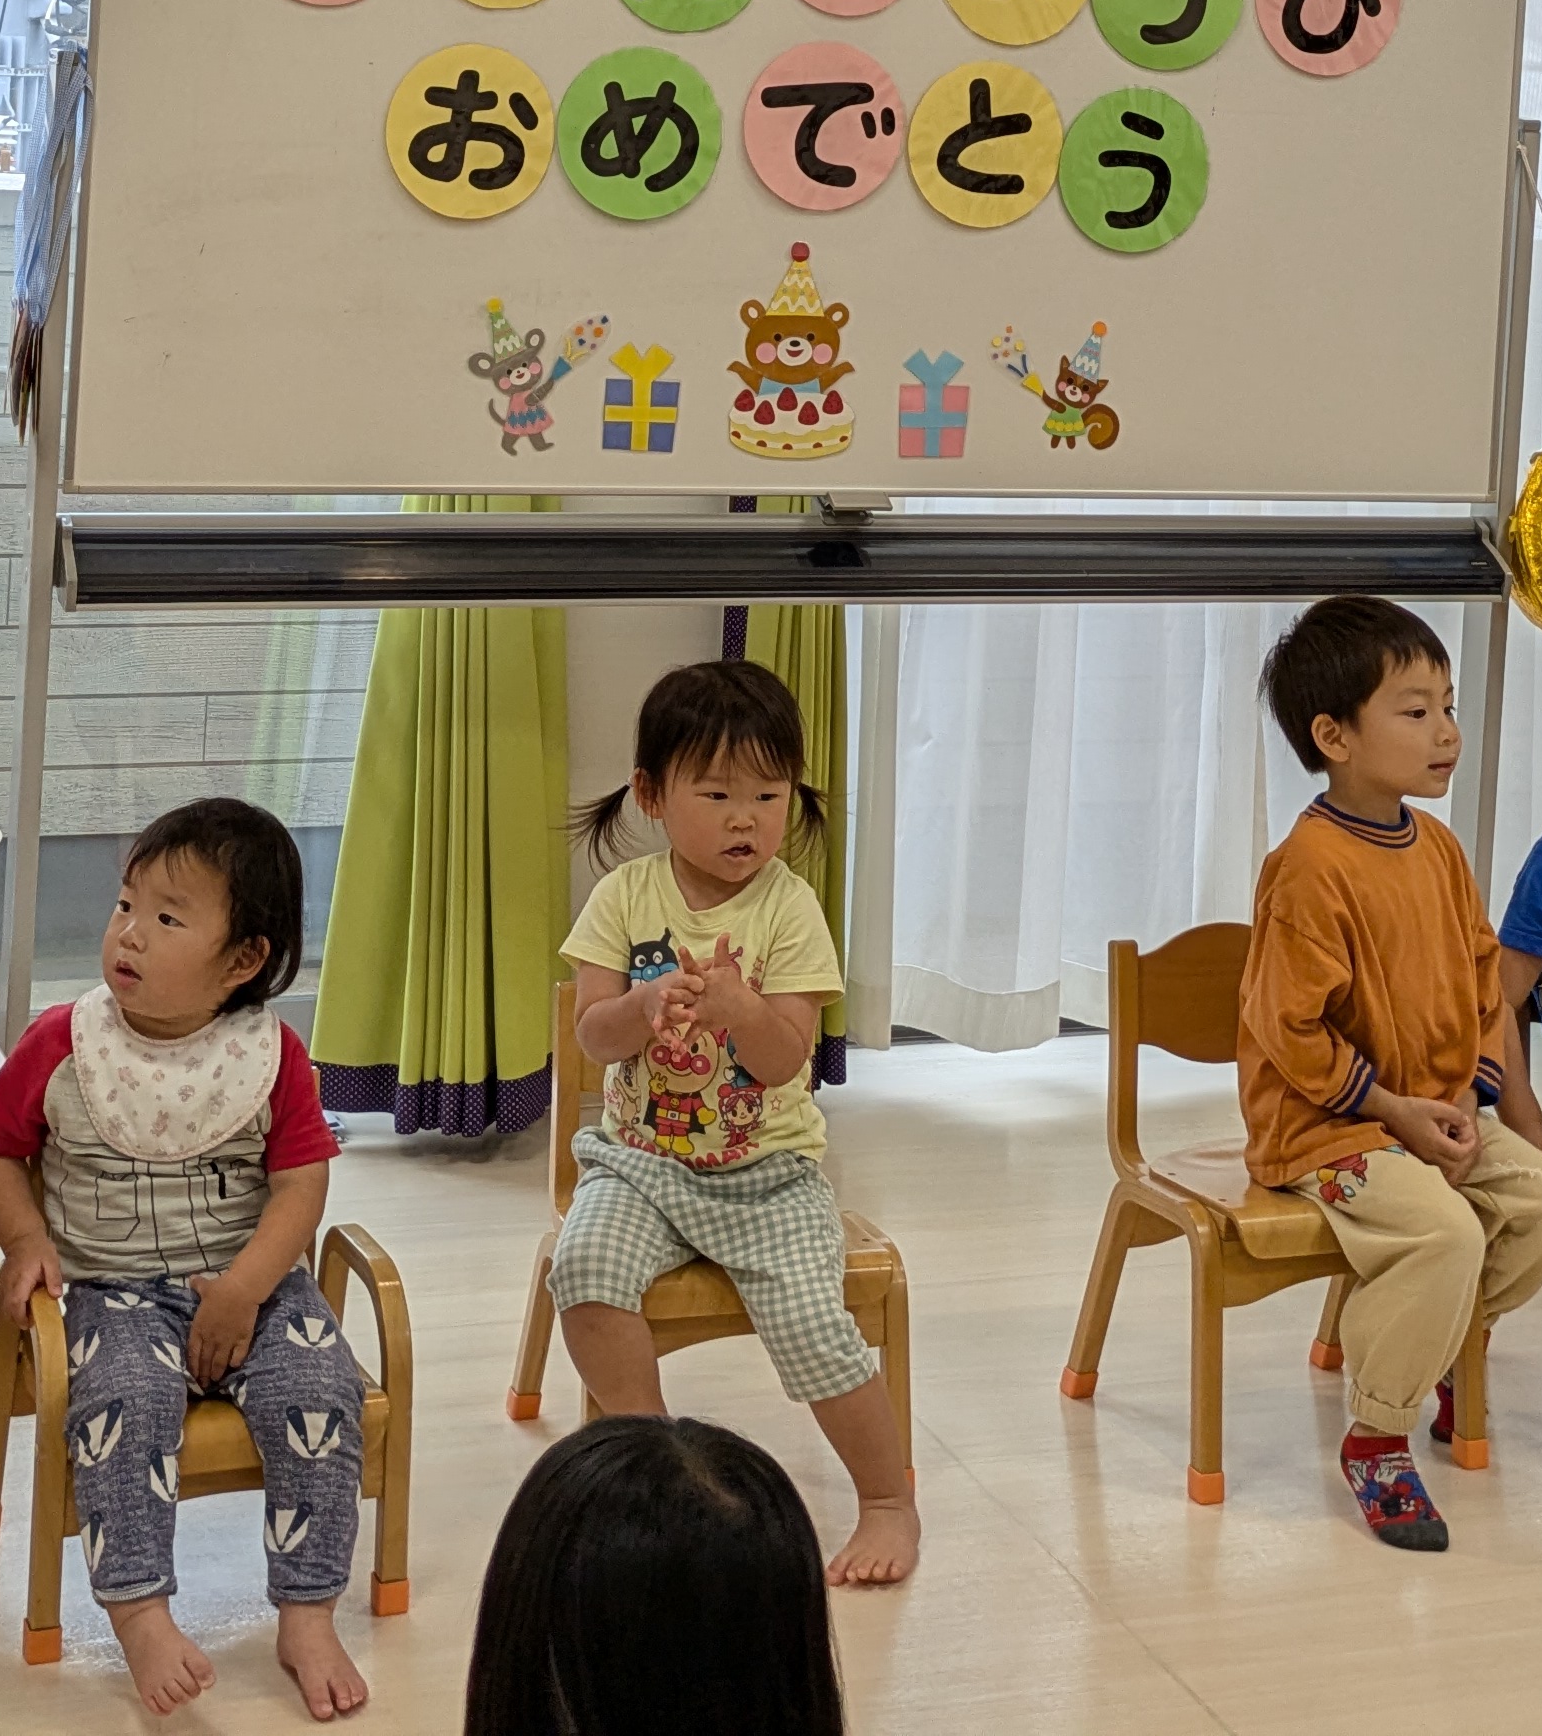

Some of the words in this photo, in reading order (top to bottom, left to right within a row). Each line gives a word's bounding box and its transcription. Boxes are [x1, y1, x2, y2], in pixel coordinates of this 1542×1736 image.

[406, 68, 1173, 231] おめでとう
